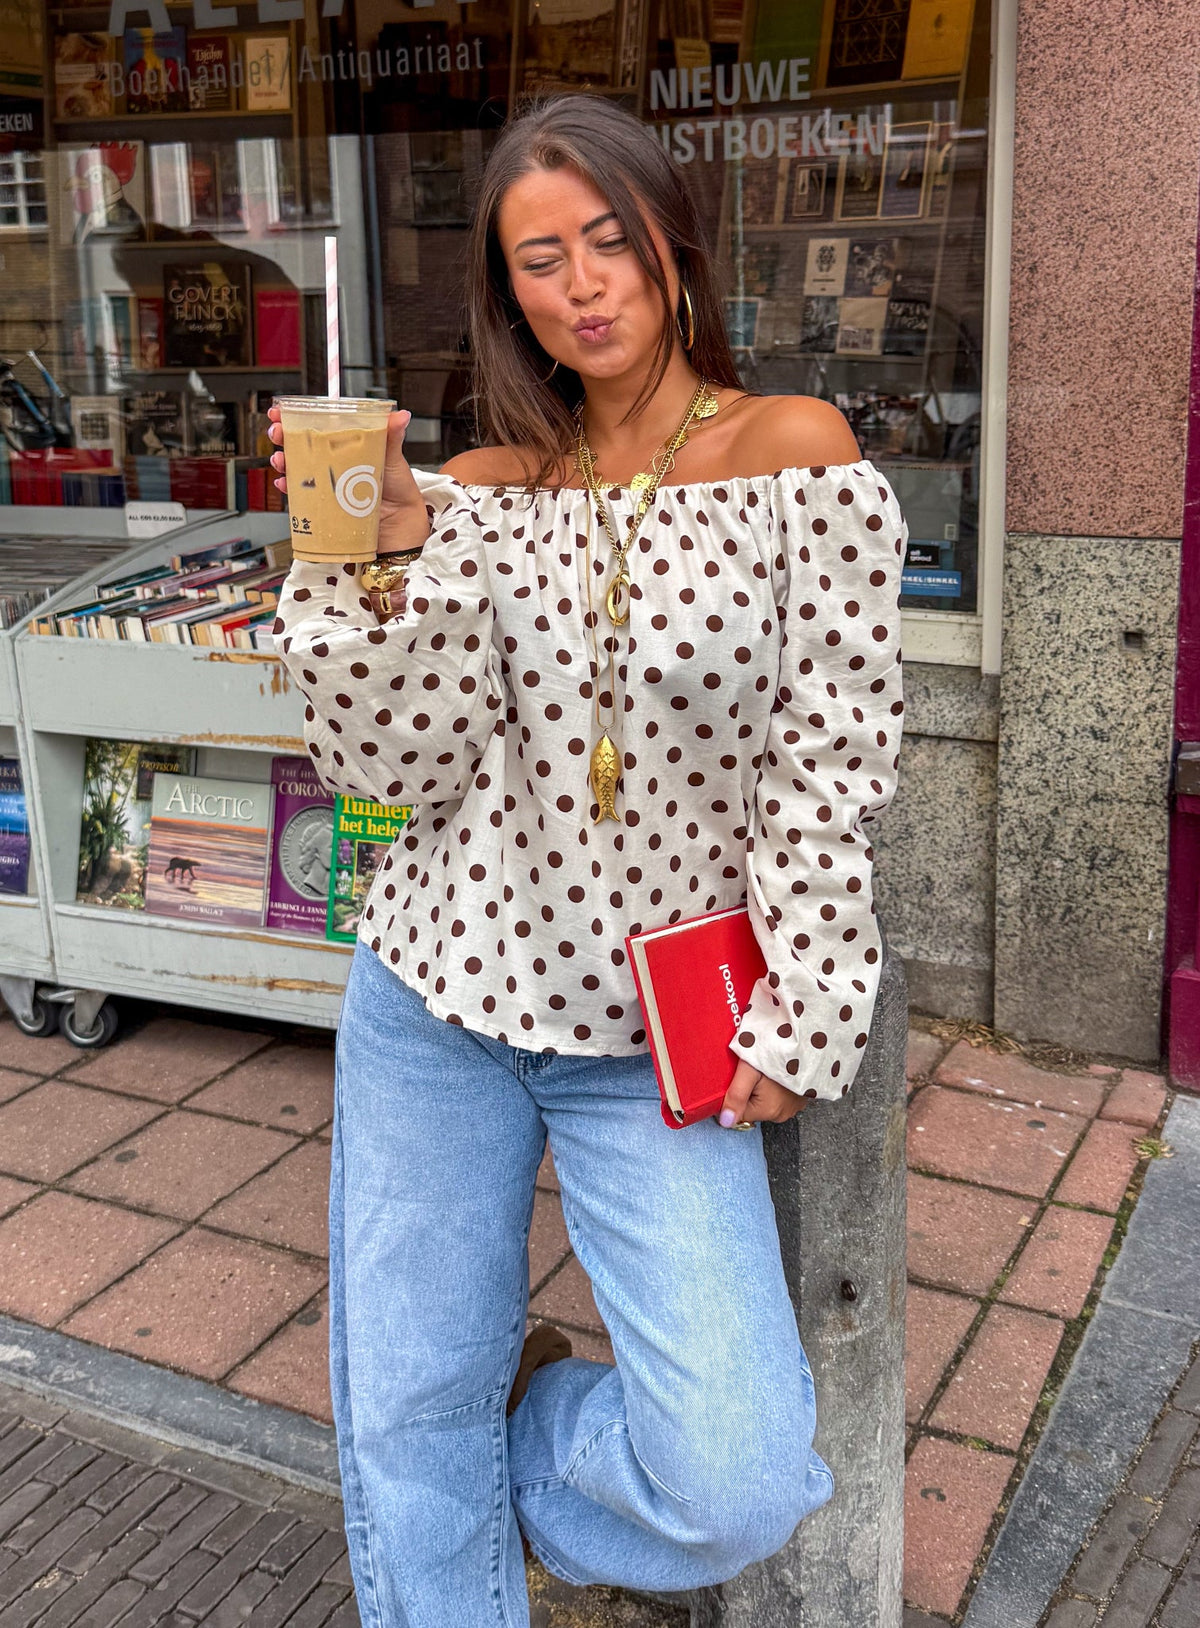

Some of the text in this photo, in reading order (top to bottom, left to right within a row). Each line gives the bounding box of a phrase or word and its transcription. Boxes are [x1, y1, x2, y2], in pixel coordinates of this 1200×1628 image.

[299, 34, 484, 86] Antiquariaat
[651, 58, 811, 110] NIEUWE
[169, 286, 240, 303] GOVERT
[175, 304, 236, 321] FLINCK
[300, 769, 317, 779] HIS
[165, 781, 254, 821] ARCTIC
[340, 794, 413, 820] Tuinier
[339, 815, 400, 838] het hele
